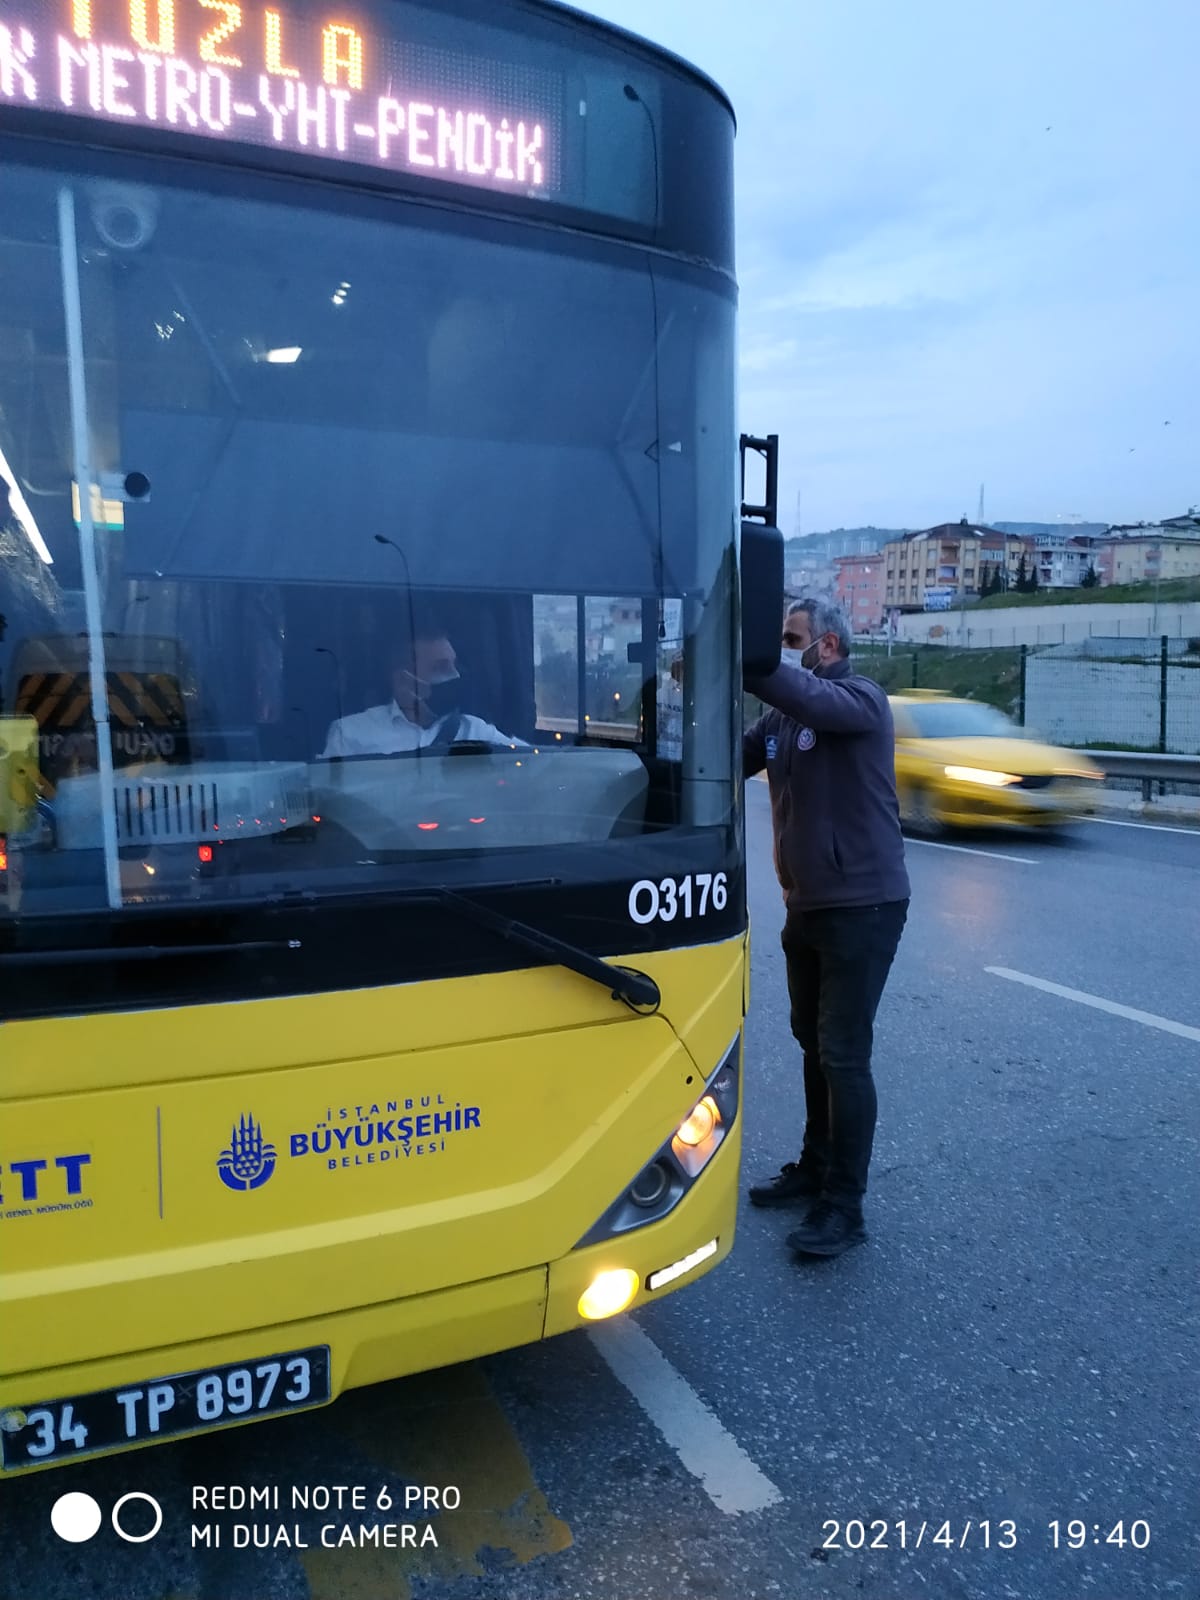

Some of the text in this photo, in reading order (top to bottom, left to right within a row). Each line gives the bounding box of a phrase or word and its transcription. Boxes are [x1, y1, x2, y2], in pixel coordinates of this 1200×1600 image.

[290, 1102, 481, 1158] BÜYÜKŞEHİR
[327, 1094, 445, 1121] İSTANBUL
[0, 1154, 92, 1204] TT
[328, 1138, 445, 1170] BELEDİYESİ
[26, 1357, 311, 1457] 34 TP 8973
